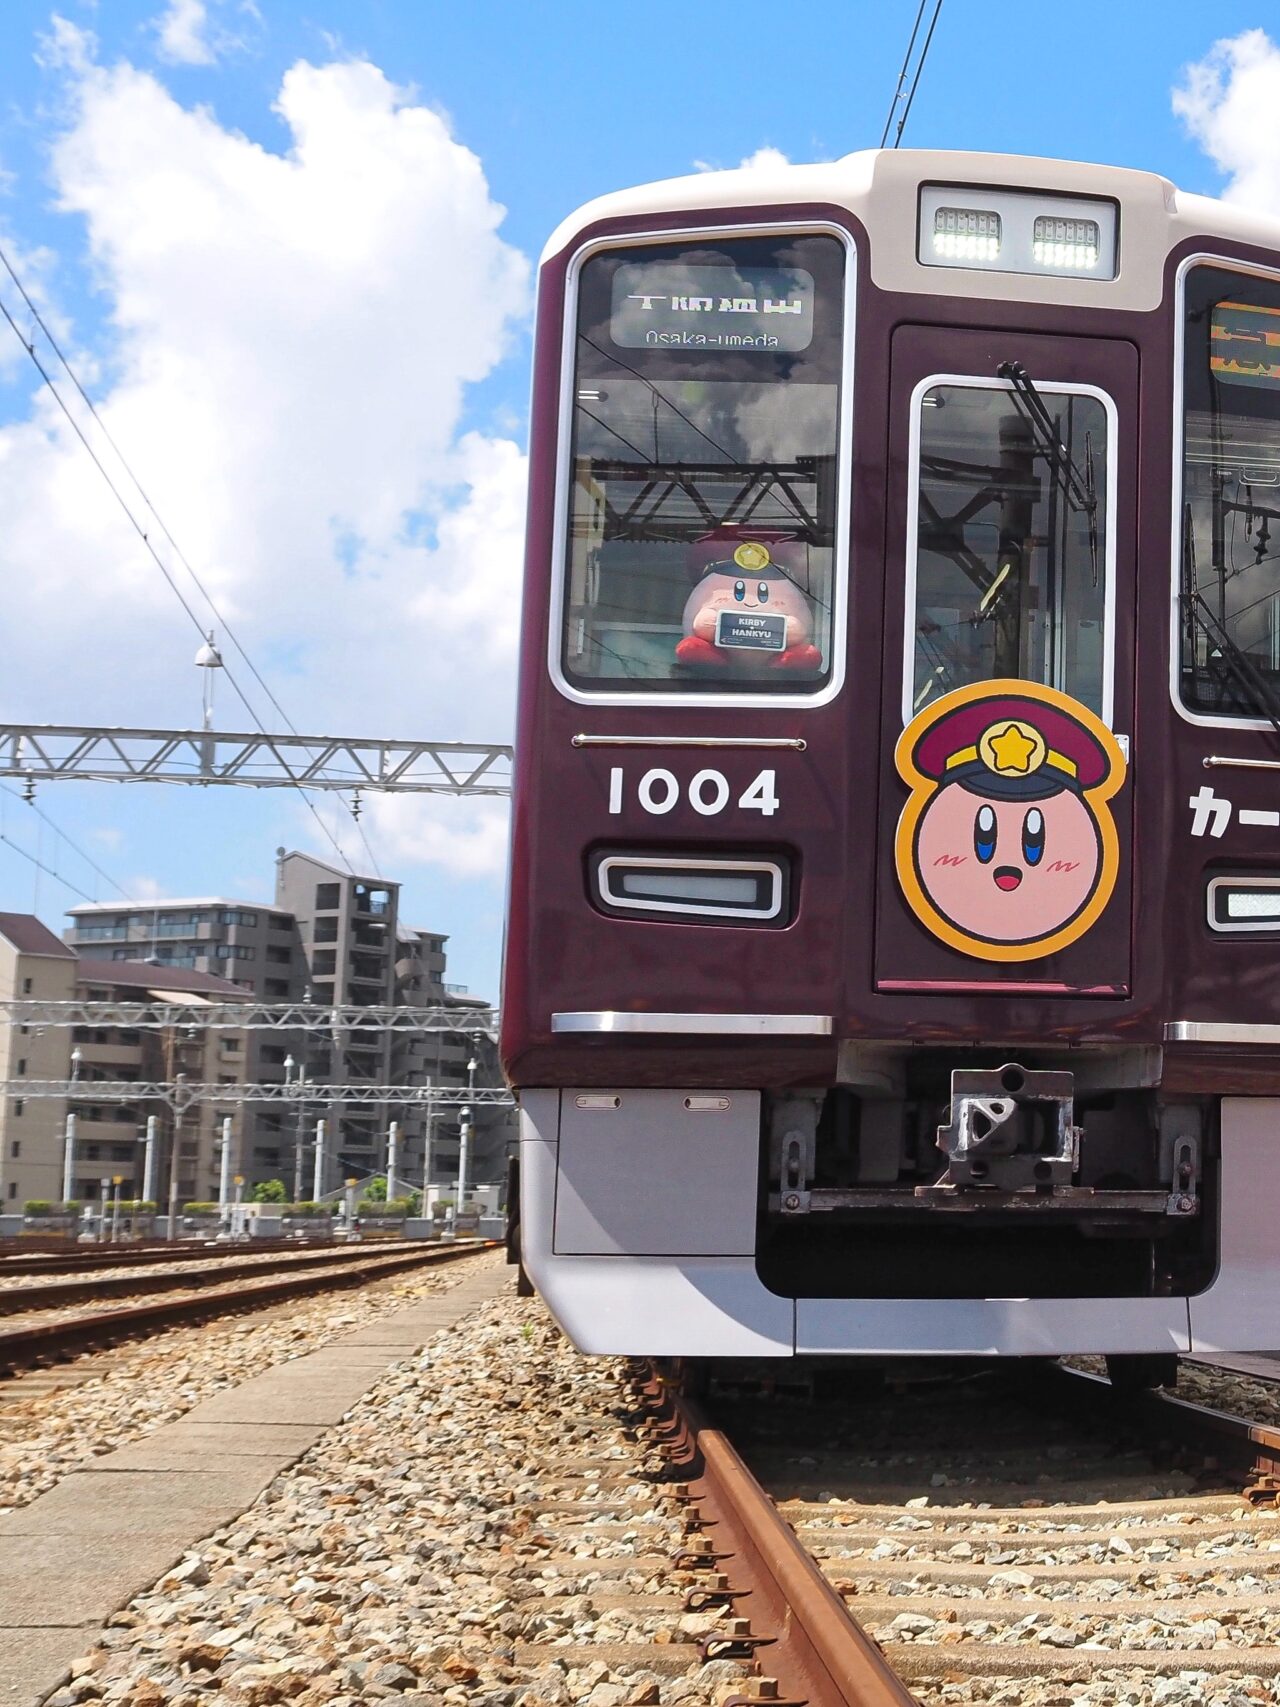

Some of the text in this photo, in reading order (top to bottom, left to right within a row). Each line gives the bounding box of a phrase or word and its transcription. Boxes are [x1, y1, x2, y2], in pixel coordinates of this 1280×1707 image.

[738, 617, 767, 627] KIRBY
[732, 628, 772, 638] HANKYU
[608, 767, 780, 816] 1004
